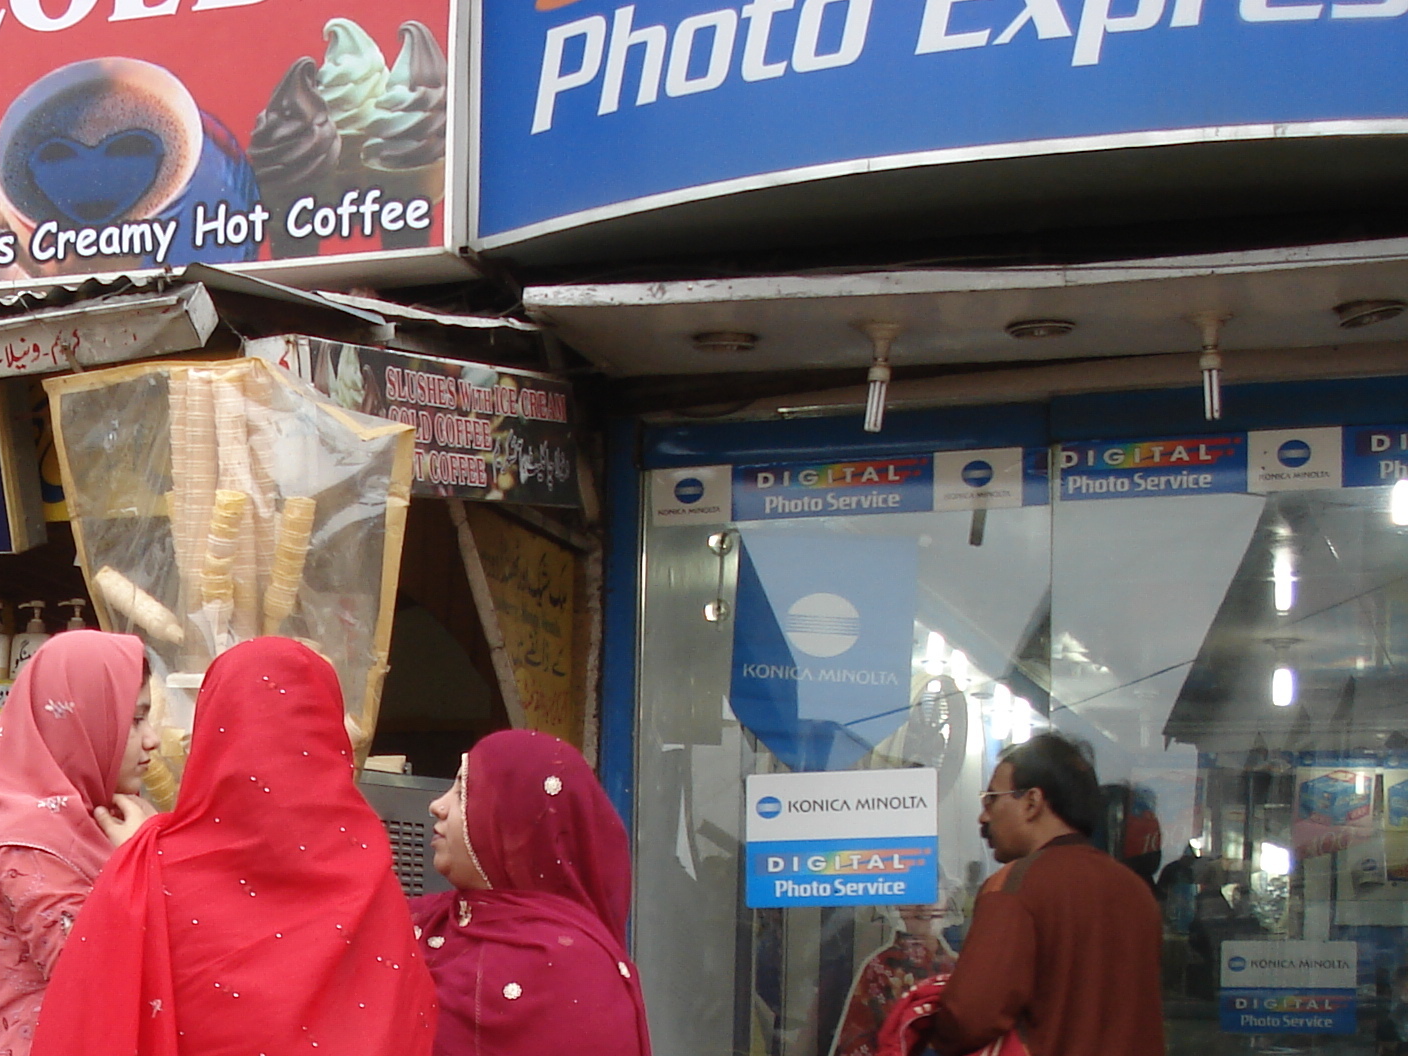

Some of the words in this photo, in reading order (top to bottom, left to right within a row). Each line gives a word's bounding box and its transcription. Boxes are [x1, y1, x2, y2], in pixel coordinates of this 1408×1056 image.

[530, 0, 872, 135] Photo
[30, 216, 178, 263] Creamy
[194, 201, 269, 248] Hot
[285, 188, 431, 241] Coffee
[385, 366, 457, 410] SLUSHES
[494, 384, 518, 418] ICE
[519, 388, 568, 423] CREAM
[434, 417, 493, 450] COFFEE
[1061, 443, 1212, 469] DIGITAL
[429, 450, 488, 488] COFFEE
[757, 464, 903, 489] DIGITAL
[1067, 473, 1130, 494] Photo
[1132, 470, 1213, 492] Service
[765, 493, 825, 515] Photo
[826, 490, 901, 513] Service
[743, 663, 812, 681] KONICA
[818, 667, 899, 686] MINOLTA
[787, 798, 852, 815] KONICA
[855, 796, 929, 812] MINOLTA
[766, 852, 907, 874] DIGITAL
[774, 879, 832, 899] Photo
[833, 877, 906, 898] Service
[1250, 959, 1297, 970] KONICA
[1299, 958, 1350, 970] MINOLTA
[1235, 997, 1333, 1010] DIGITAL
[1240, 1014, 1281, 1028] Photo
[1283, 1014, 1333, 1029] Service
